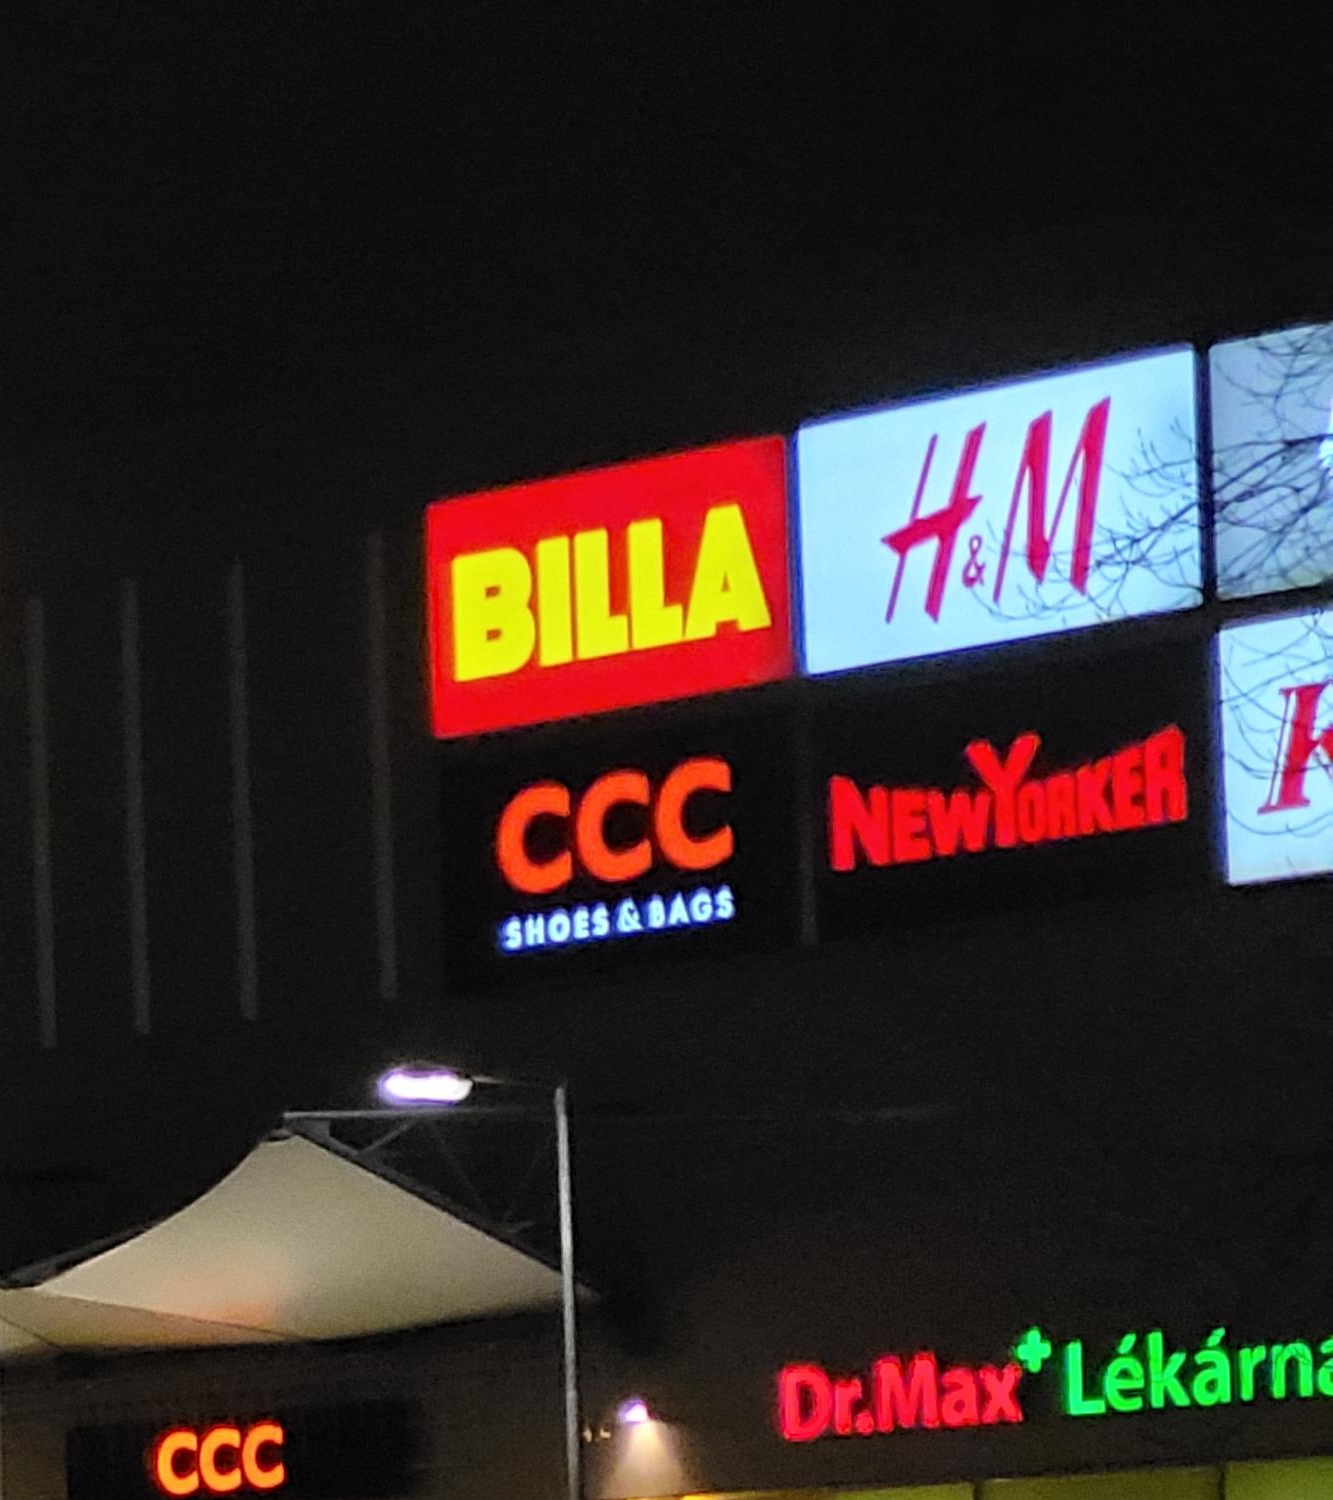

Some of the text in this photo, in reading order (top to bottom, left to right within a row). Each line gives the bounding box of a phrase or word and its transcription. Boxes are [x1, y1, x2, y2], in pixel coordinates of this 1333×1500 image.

[880, 396, 1113, 625] H&M
[452, 504, 771, 683] BILLA
[496, 755, 734, 895] CCC
[501, 883, 735, 952] SHOES & BAGS
[778, 1352, 1024, 1442] Dr.Max
[156, 1419, 285, 1495] CCC
